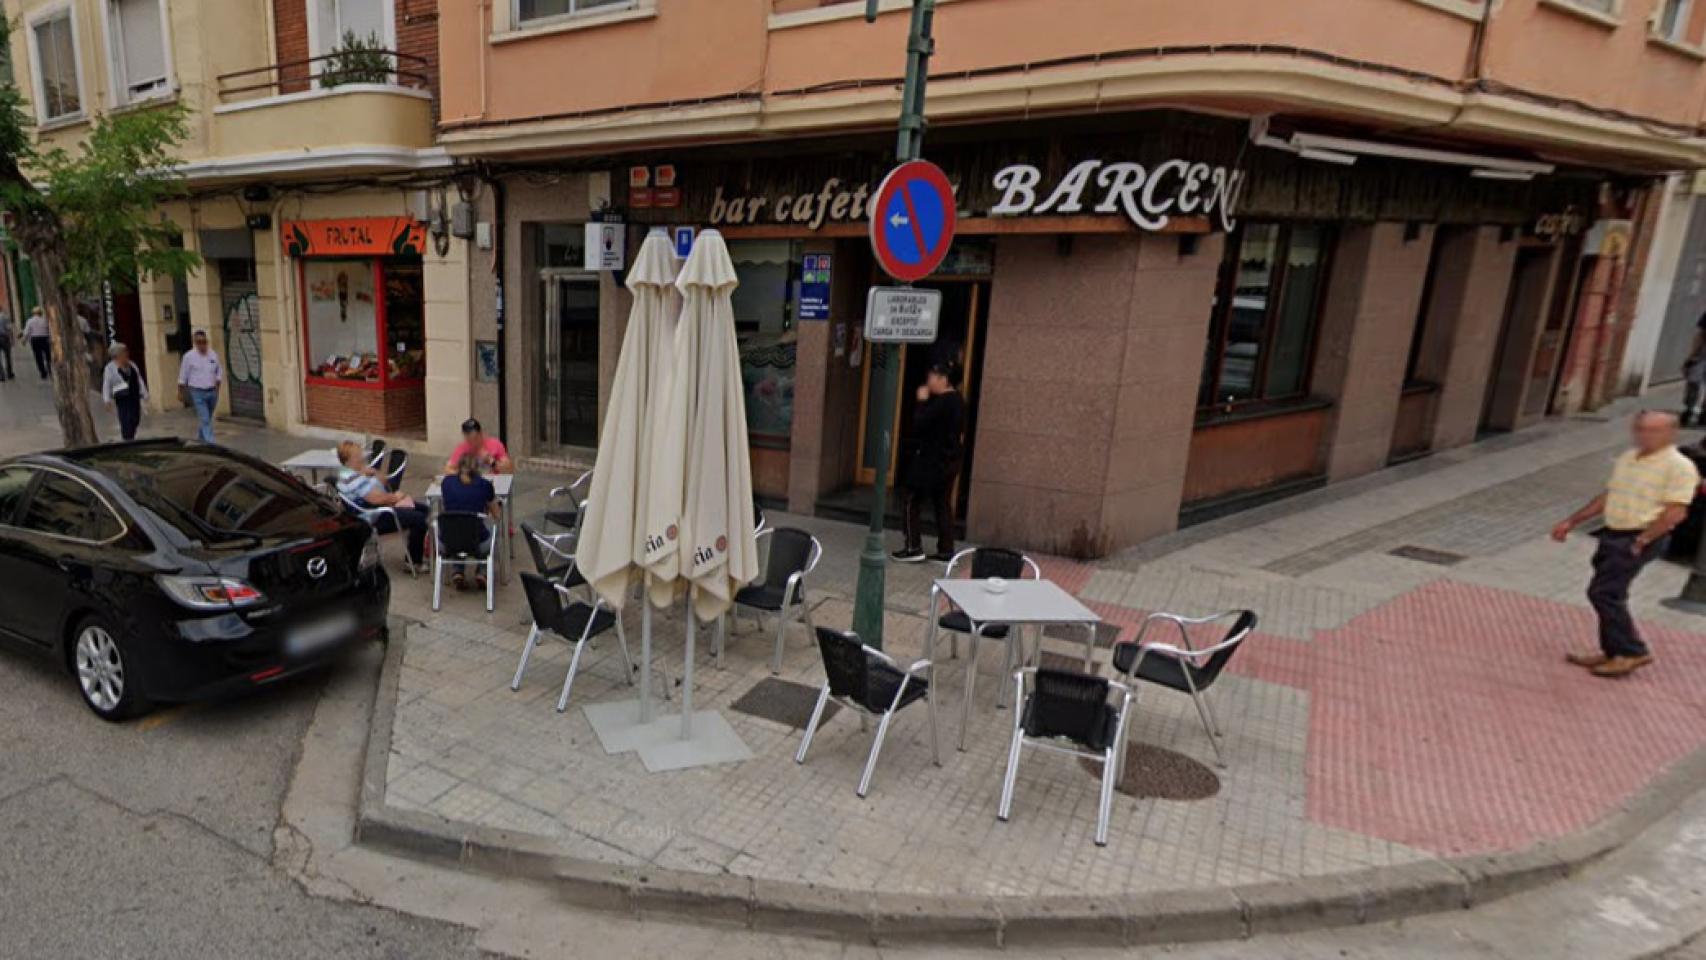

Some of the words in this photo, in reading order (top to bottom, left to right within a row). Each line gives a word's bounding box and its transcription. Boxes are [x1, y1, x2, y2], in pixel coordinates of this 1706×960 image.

[709, 186, 767, 224] bar
[326, 226, 373, 246] FRUTAL
[886, 295, 928, 304] LABORABLES
[891, 316, 919, 326] EXCEPTO
[872, 328, 893, 336] CARGA
[902, 328, 935, 336] DESCARGA
